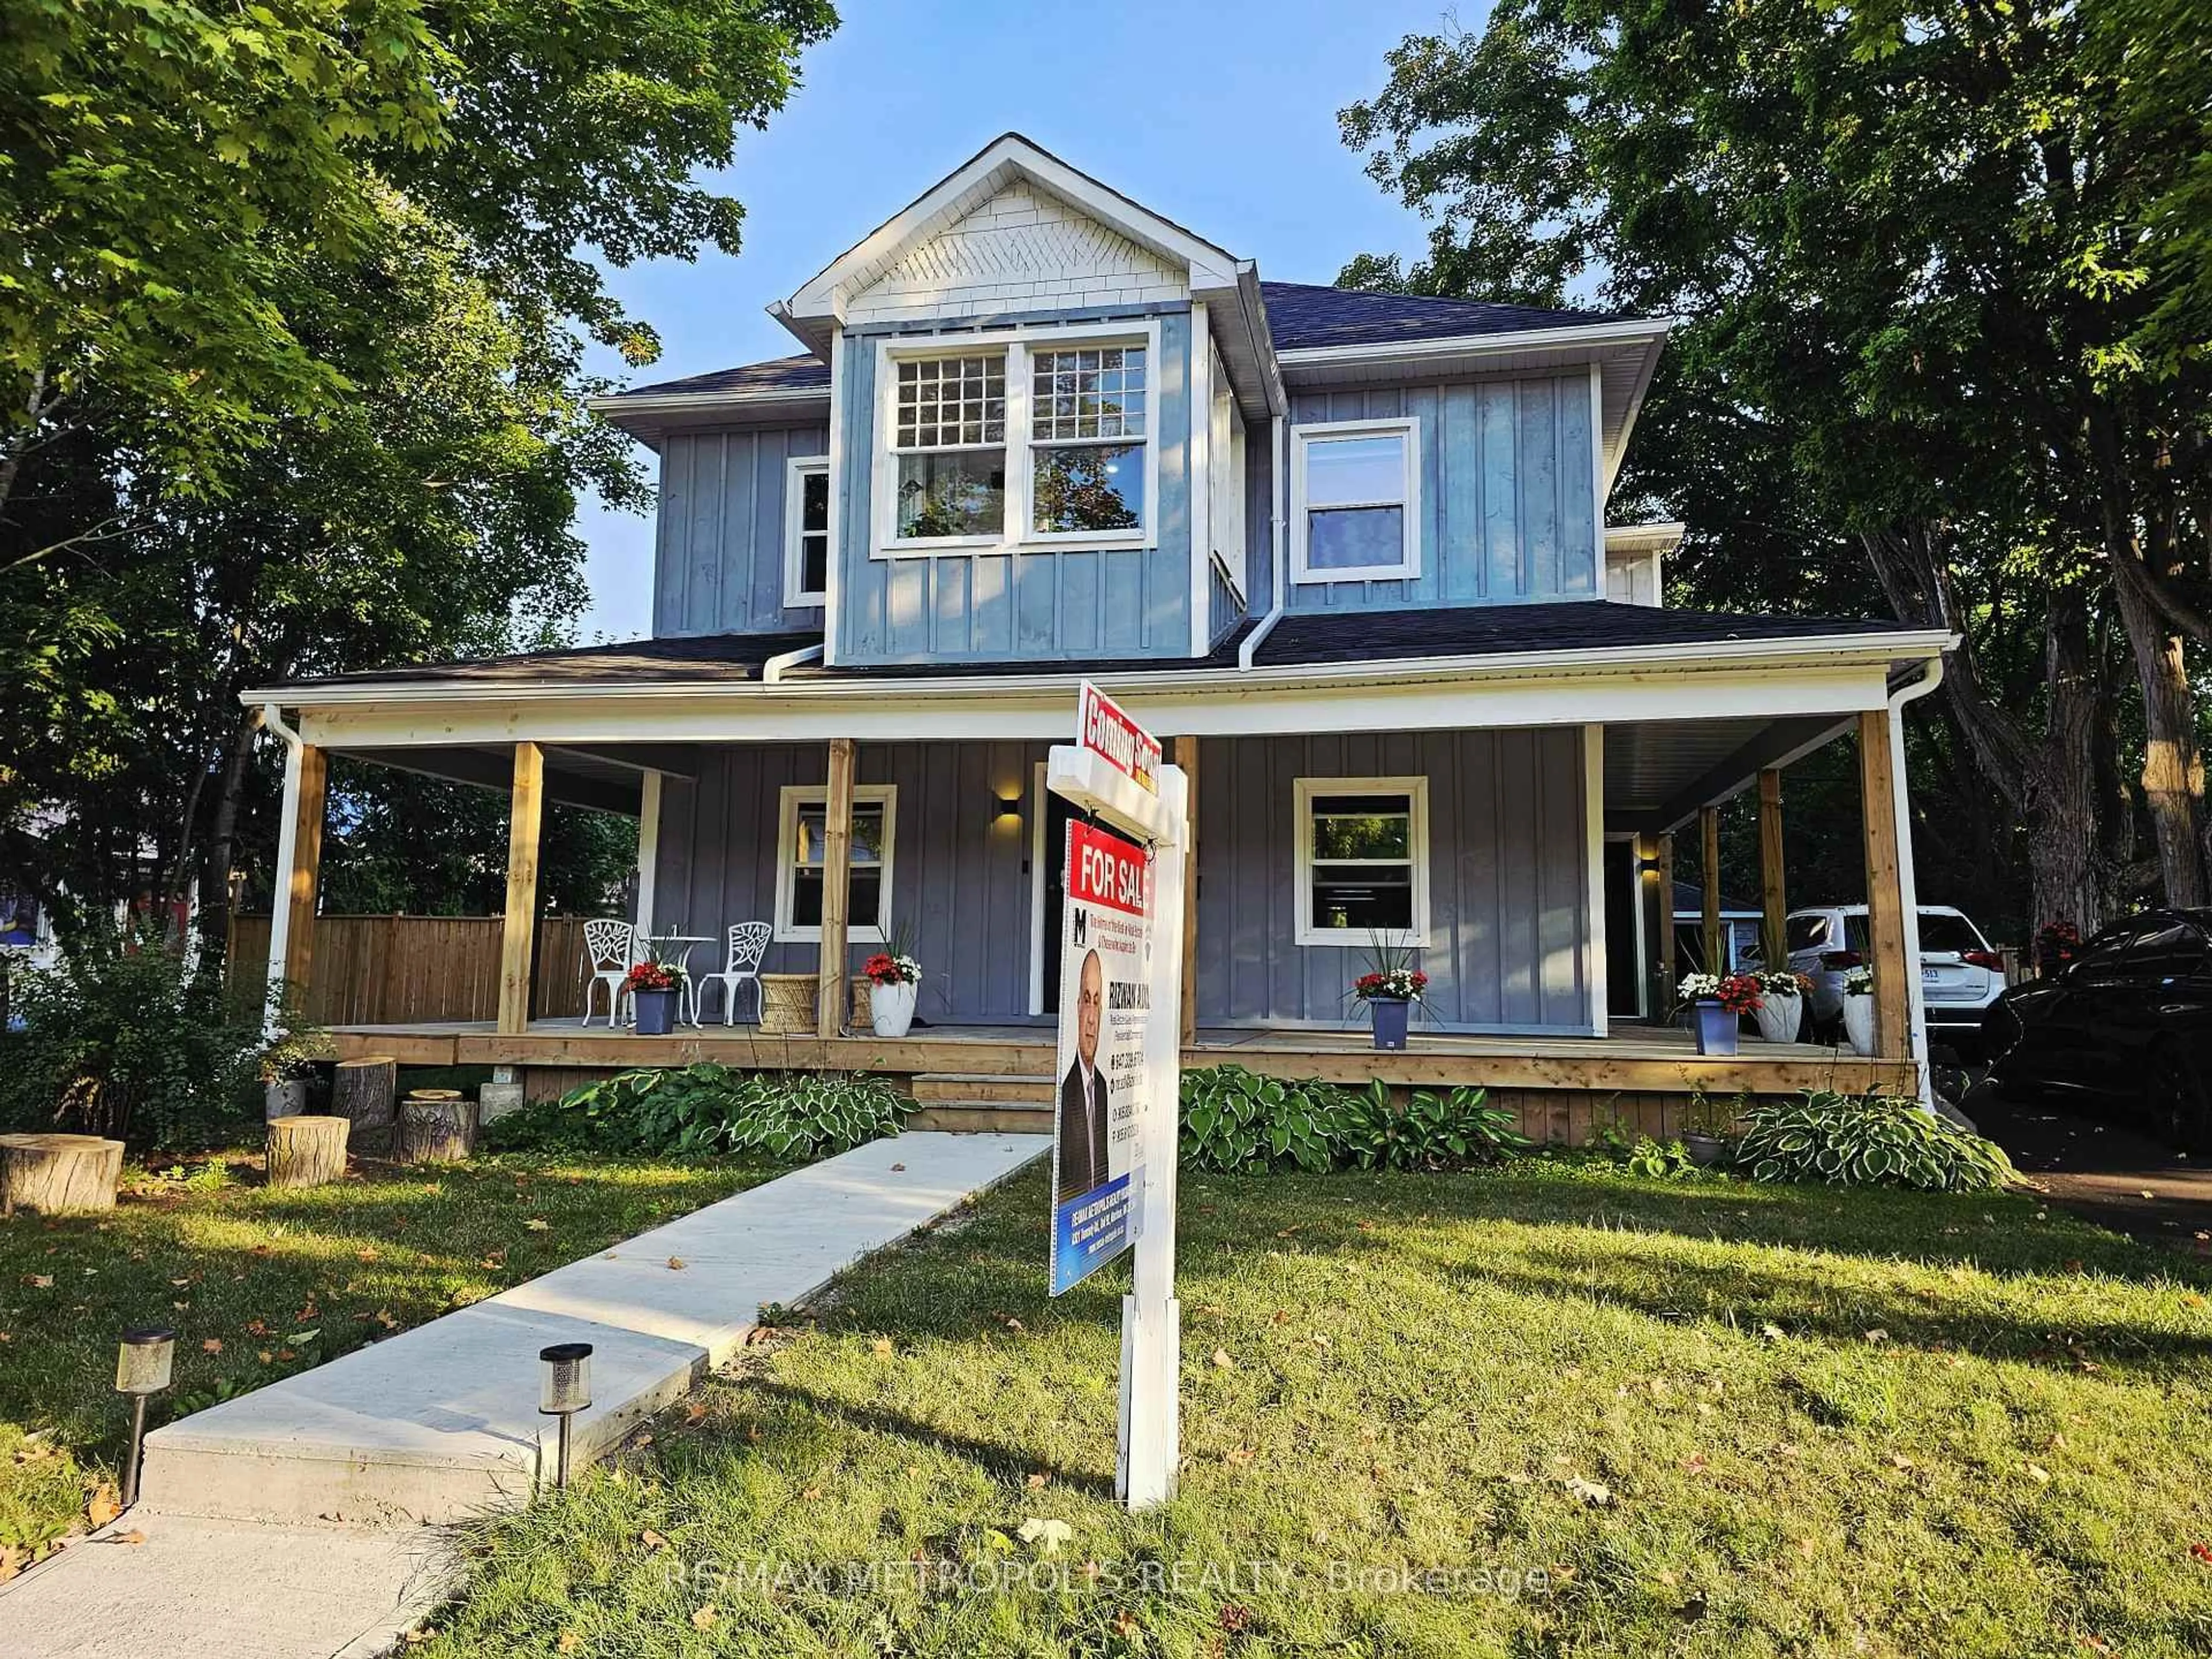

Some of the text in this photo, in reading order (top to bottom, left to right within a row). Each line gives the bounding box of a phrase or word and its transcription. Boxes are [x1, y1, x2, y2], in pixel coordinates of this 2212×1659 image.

[1087, 694, 1135, 776] Coming
[1081, 843, 1151, 912] FOR SALE
